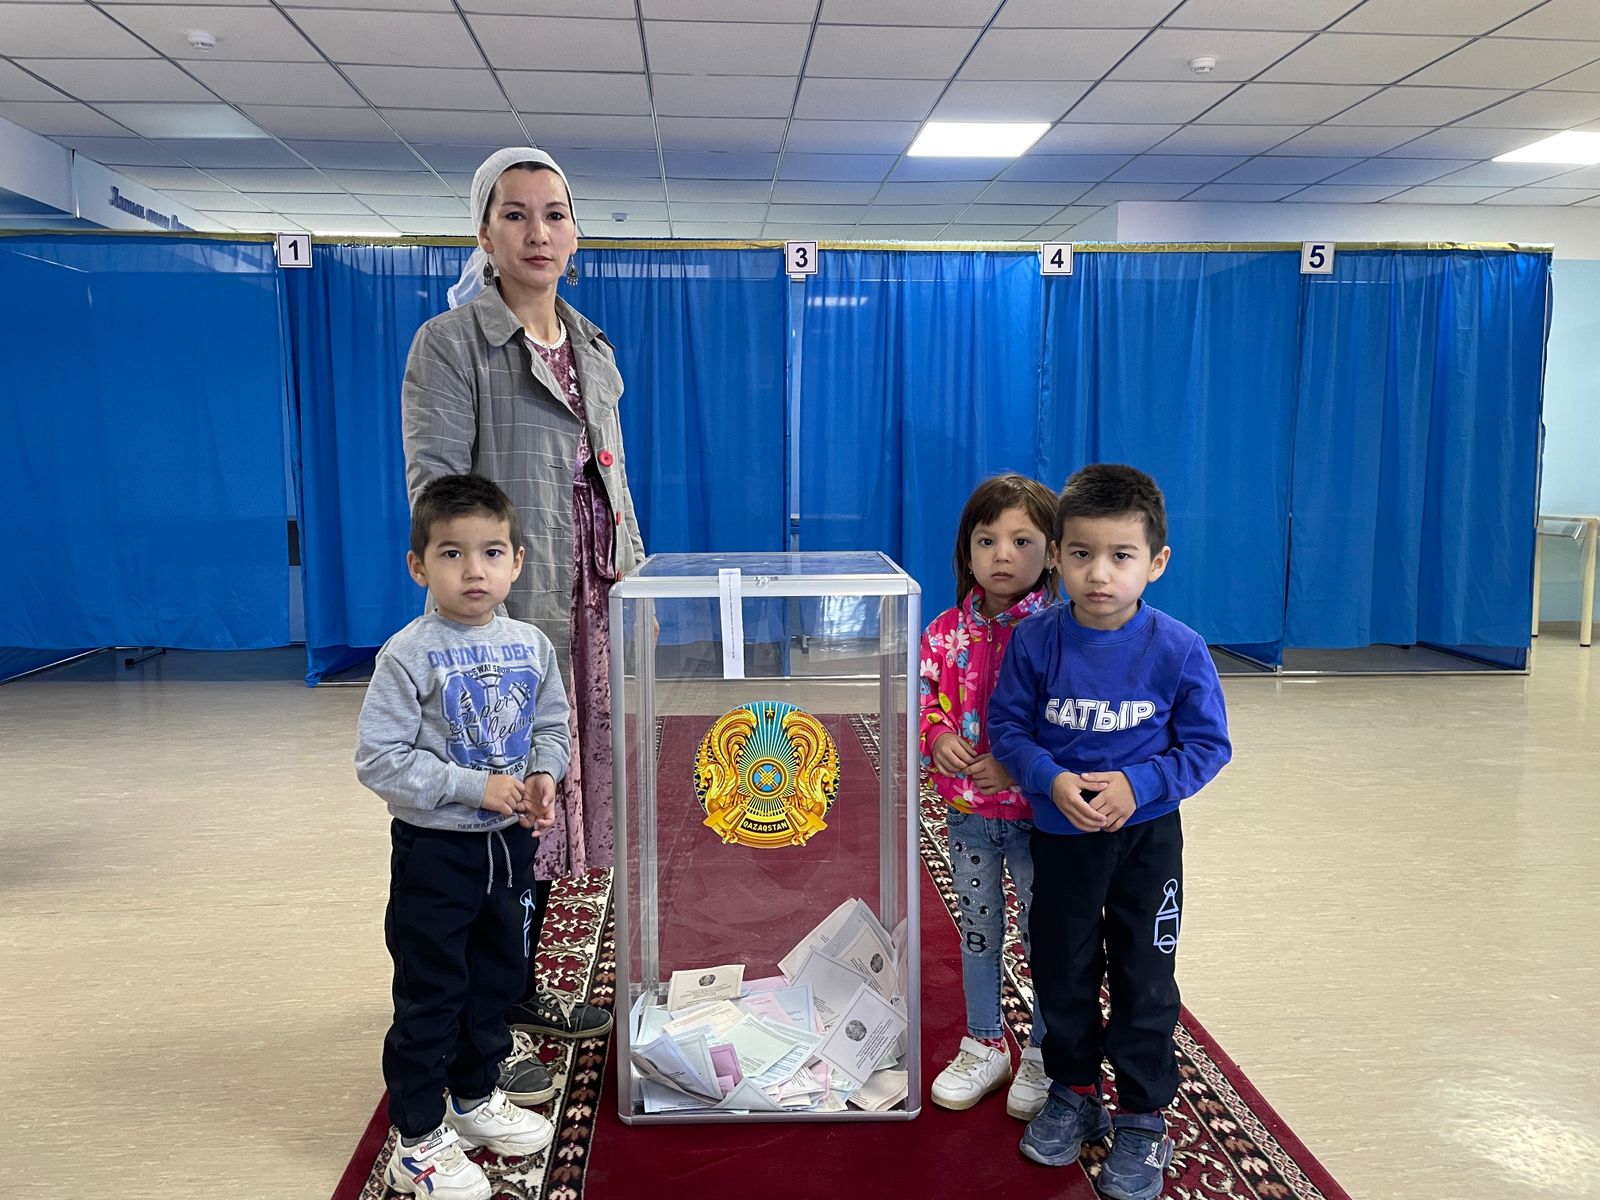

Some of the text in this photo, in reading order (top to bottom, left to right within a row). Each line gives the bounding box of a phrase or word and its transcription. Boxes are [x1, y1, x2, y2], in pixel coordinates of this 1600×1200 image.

[288, 239, 299, 261] 1
[795, 247, 809, 268] 3
[1050, 248, 1065, 268] 4
[1308, 244, 1326, 269] 5
[1045, 698, 1156, 733] БАТЫР
[742, 820, 788, 832] QAZAQSTAN
